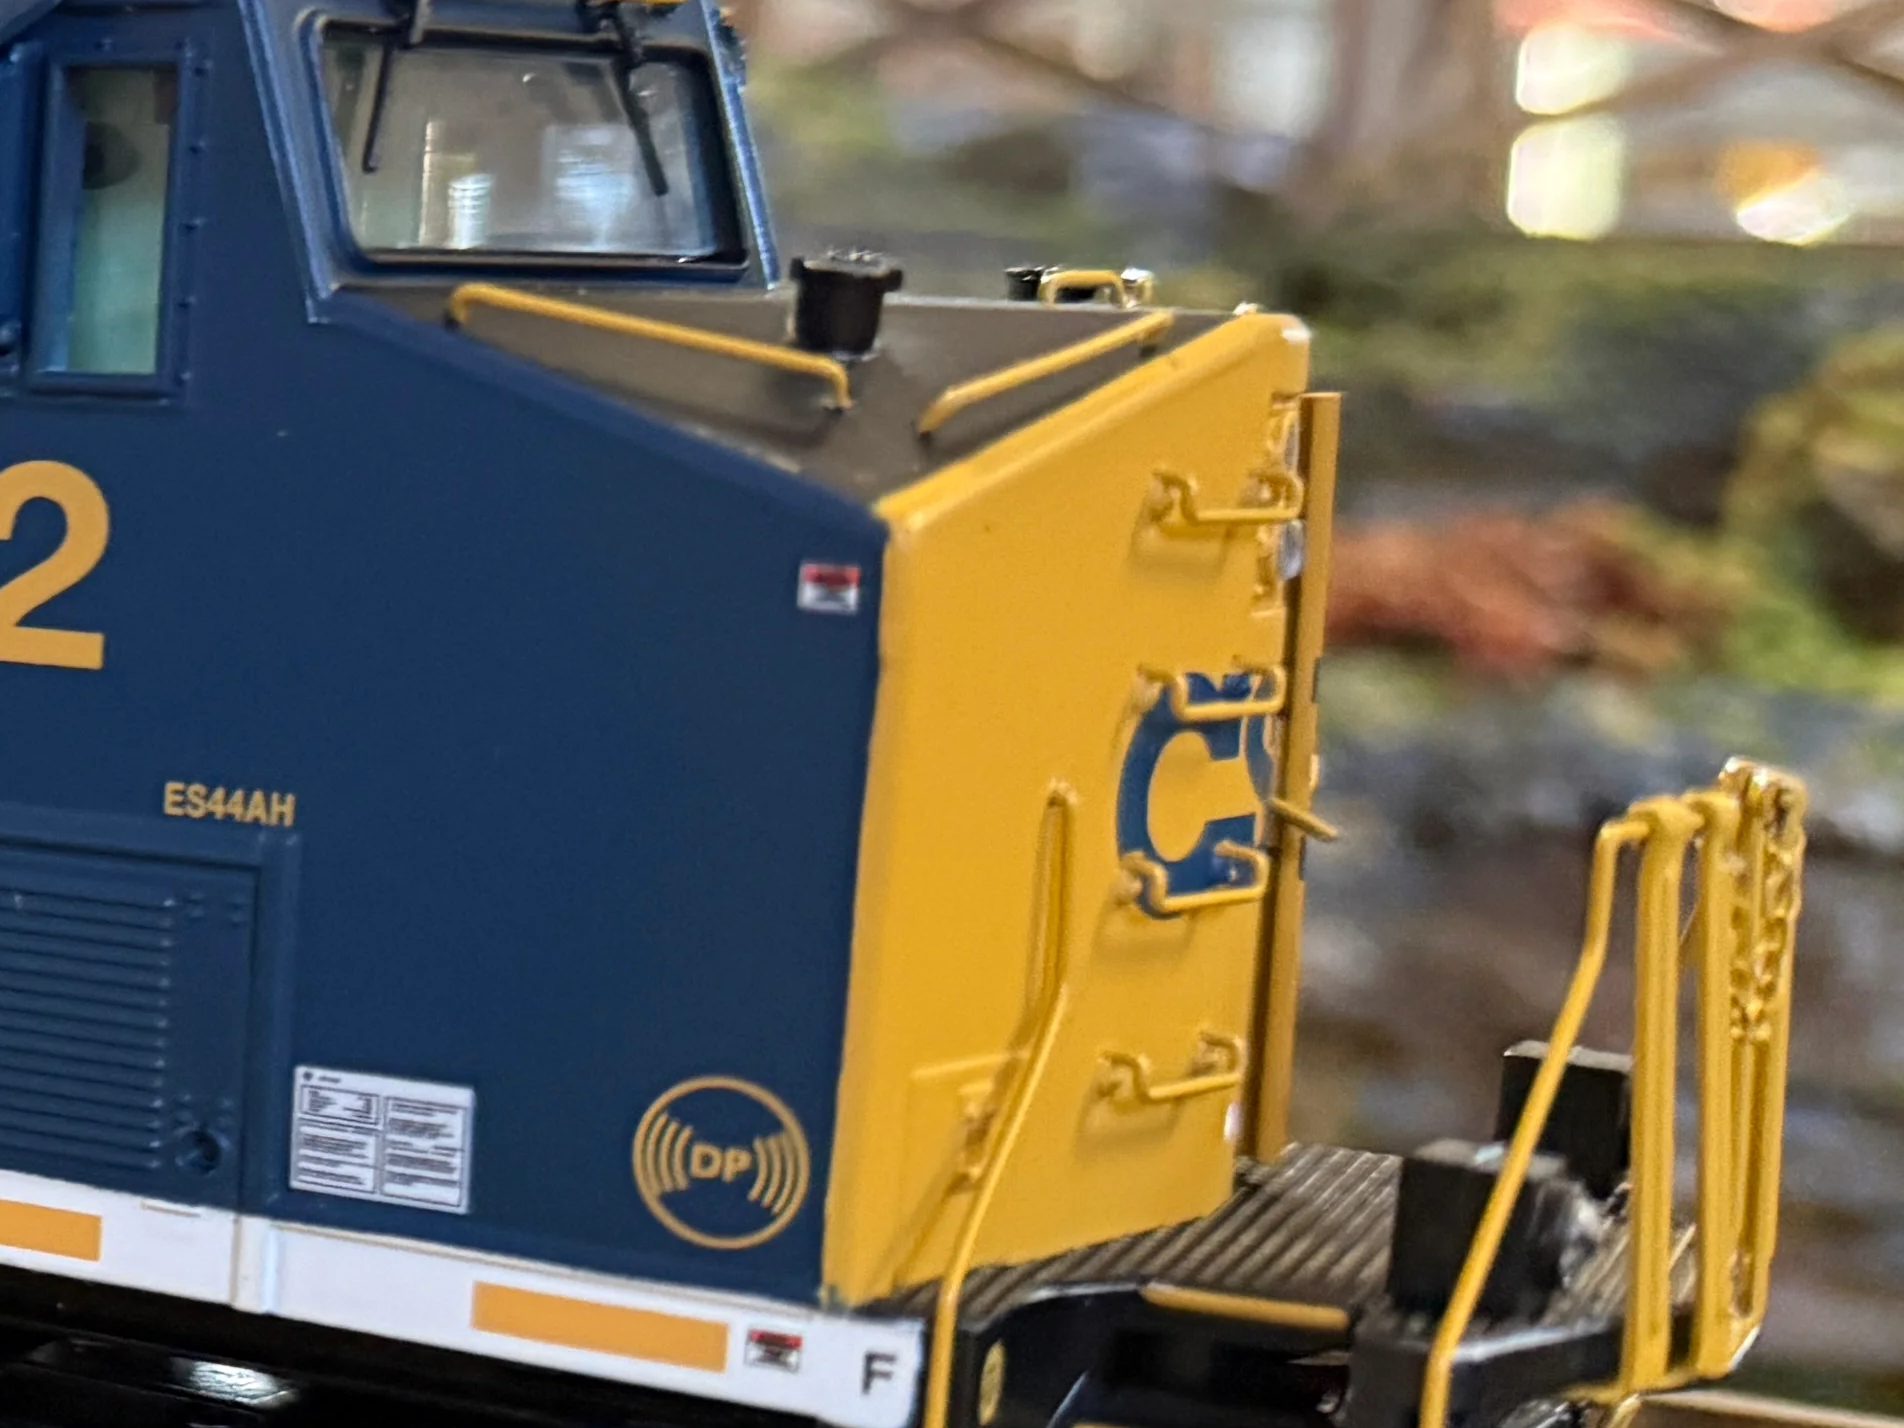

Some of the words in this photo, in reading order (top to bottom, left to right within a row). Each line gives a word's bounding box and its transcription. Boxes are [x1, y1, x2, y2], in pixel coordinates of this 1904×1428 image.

[163, 780, 297, 828] ES44AH
[690, 1141, 753, 1184] DP
[862, 1350, 898, 1397] F
